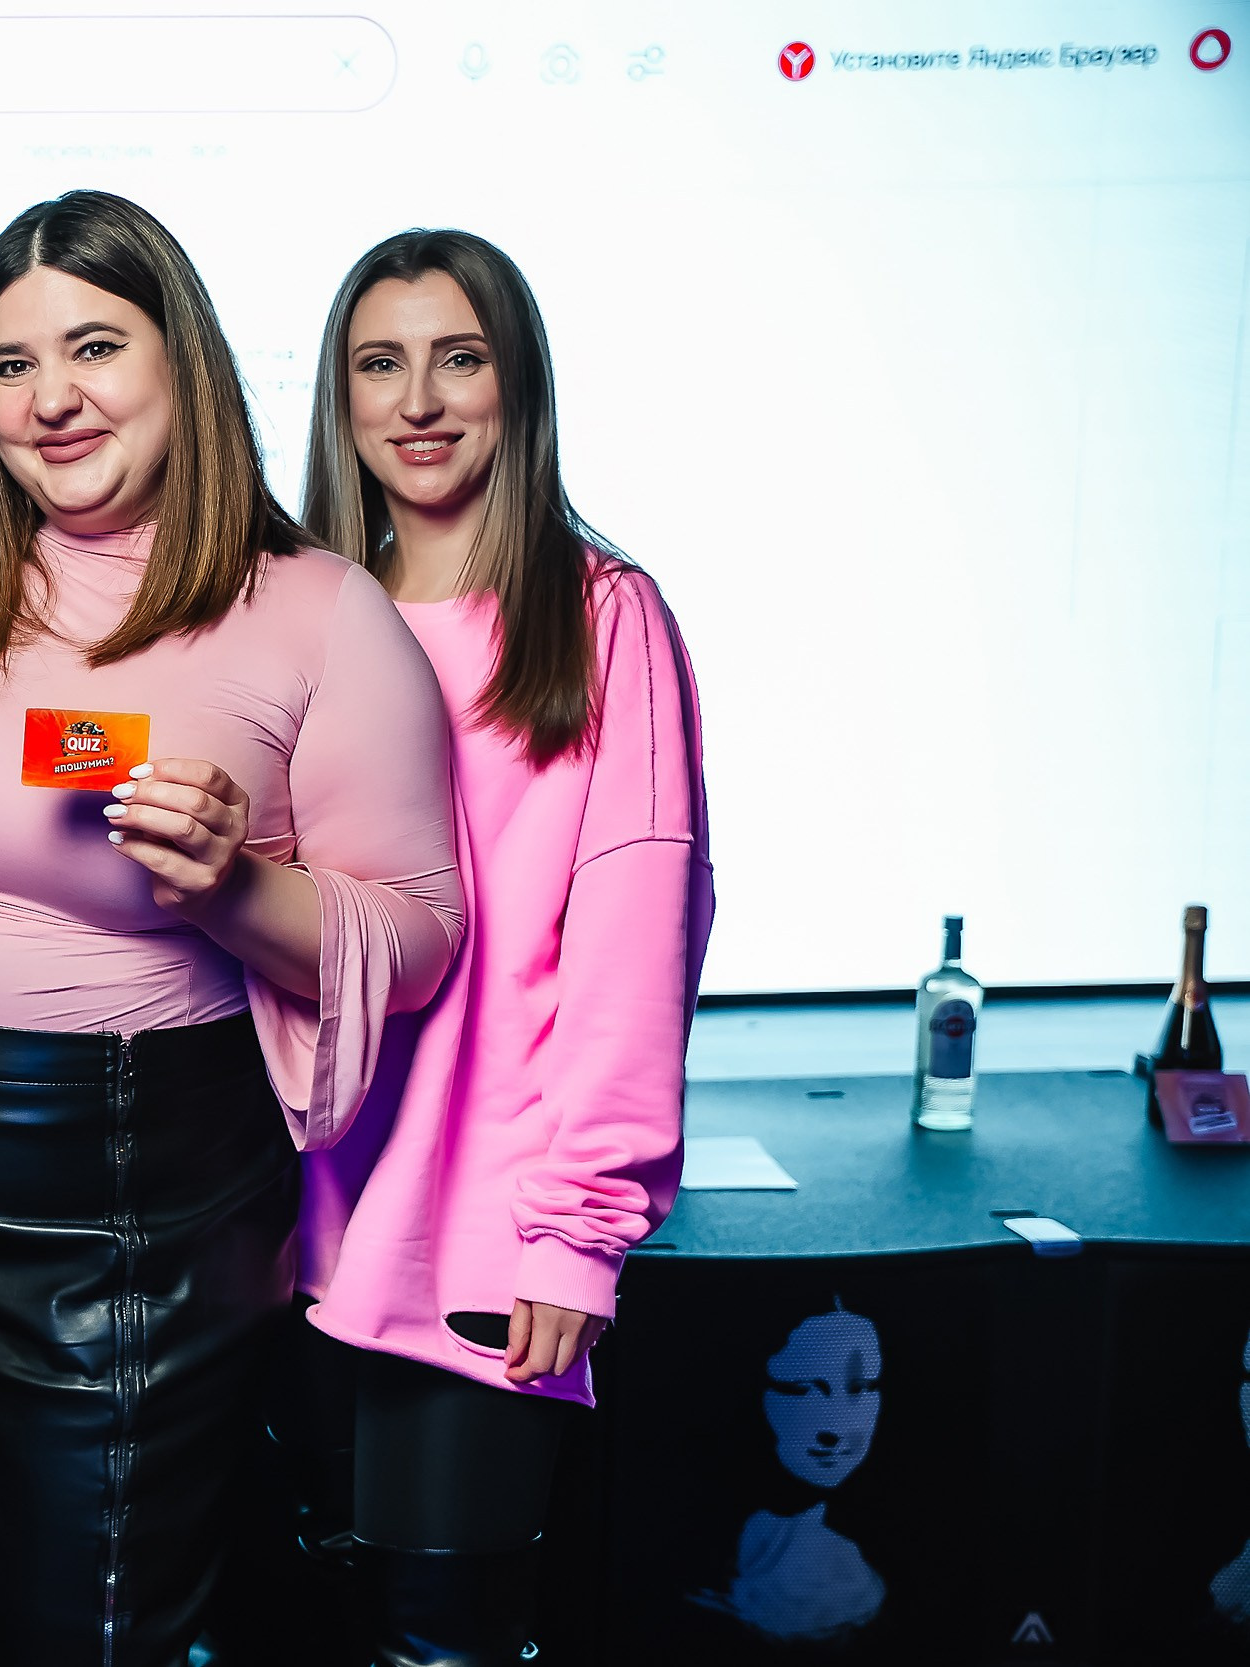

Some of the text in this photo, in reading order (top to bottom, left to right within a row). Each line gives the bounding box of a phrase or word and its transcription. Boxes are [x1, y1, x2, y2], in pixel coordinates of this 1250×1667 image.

[830, 42, 1159, 72] Установите Яндекс Браузер
[67, 737, 101, 752] QUIZ
[54, 757, 115, 774] #ПОШУМИМ?
